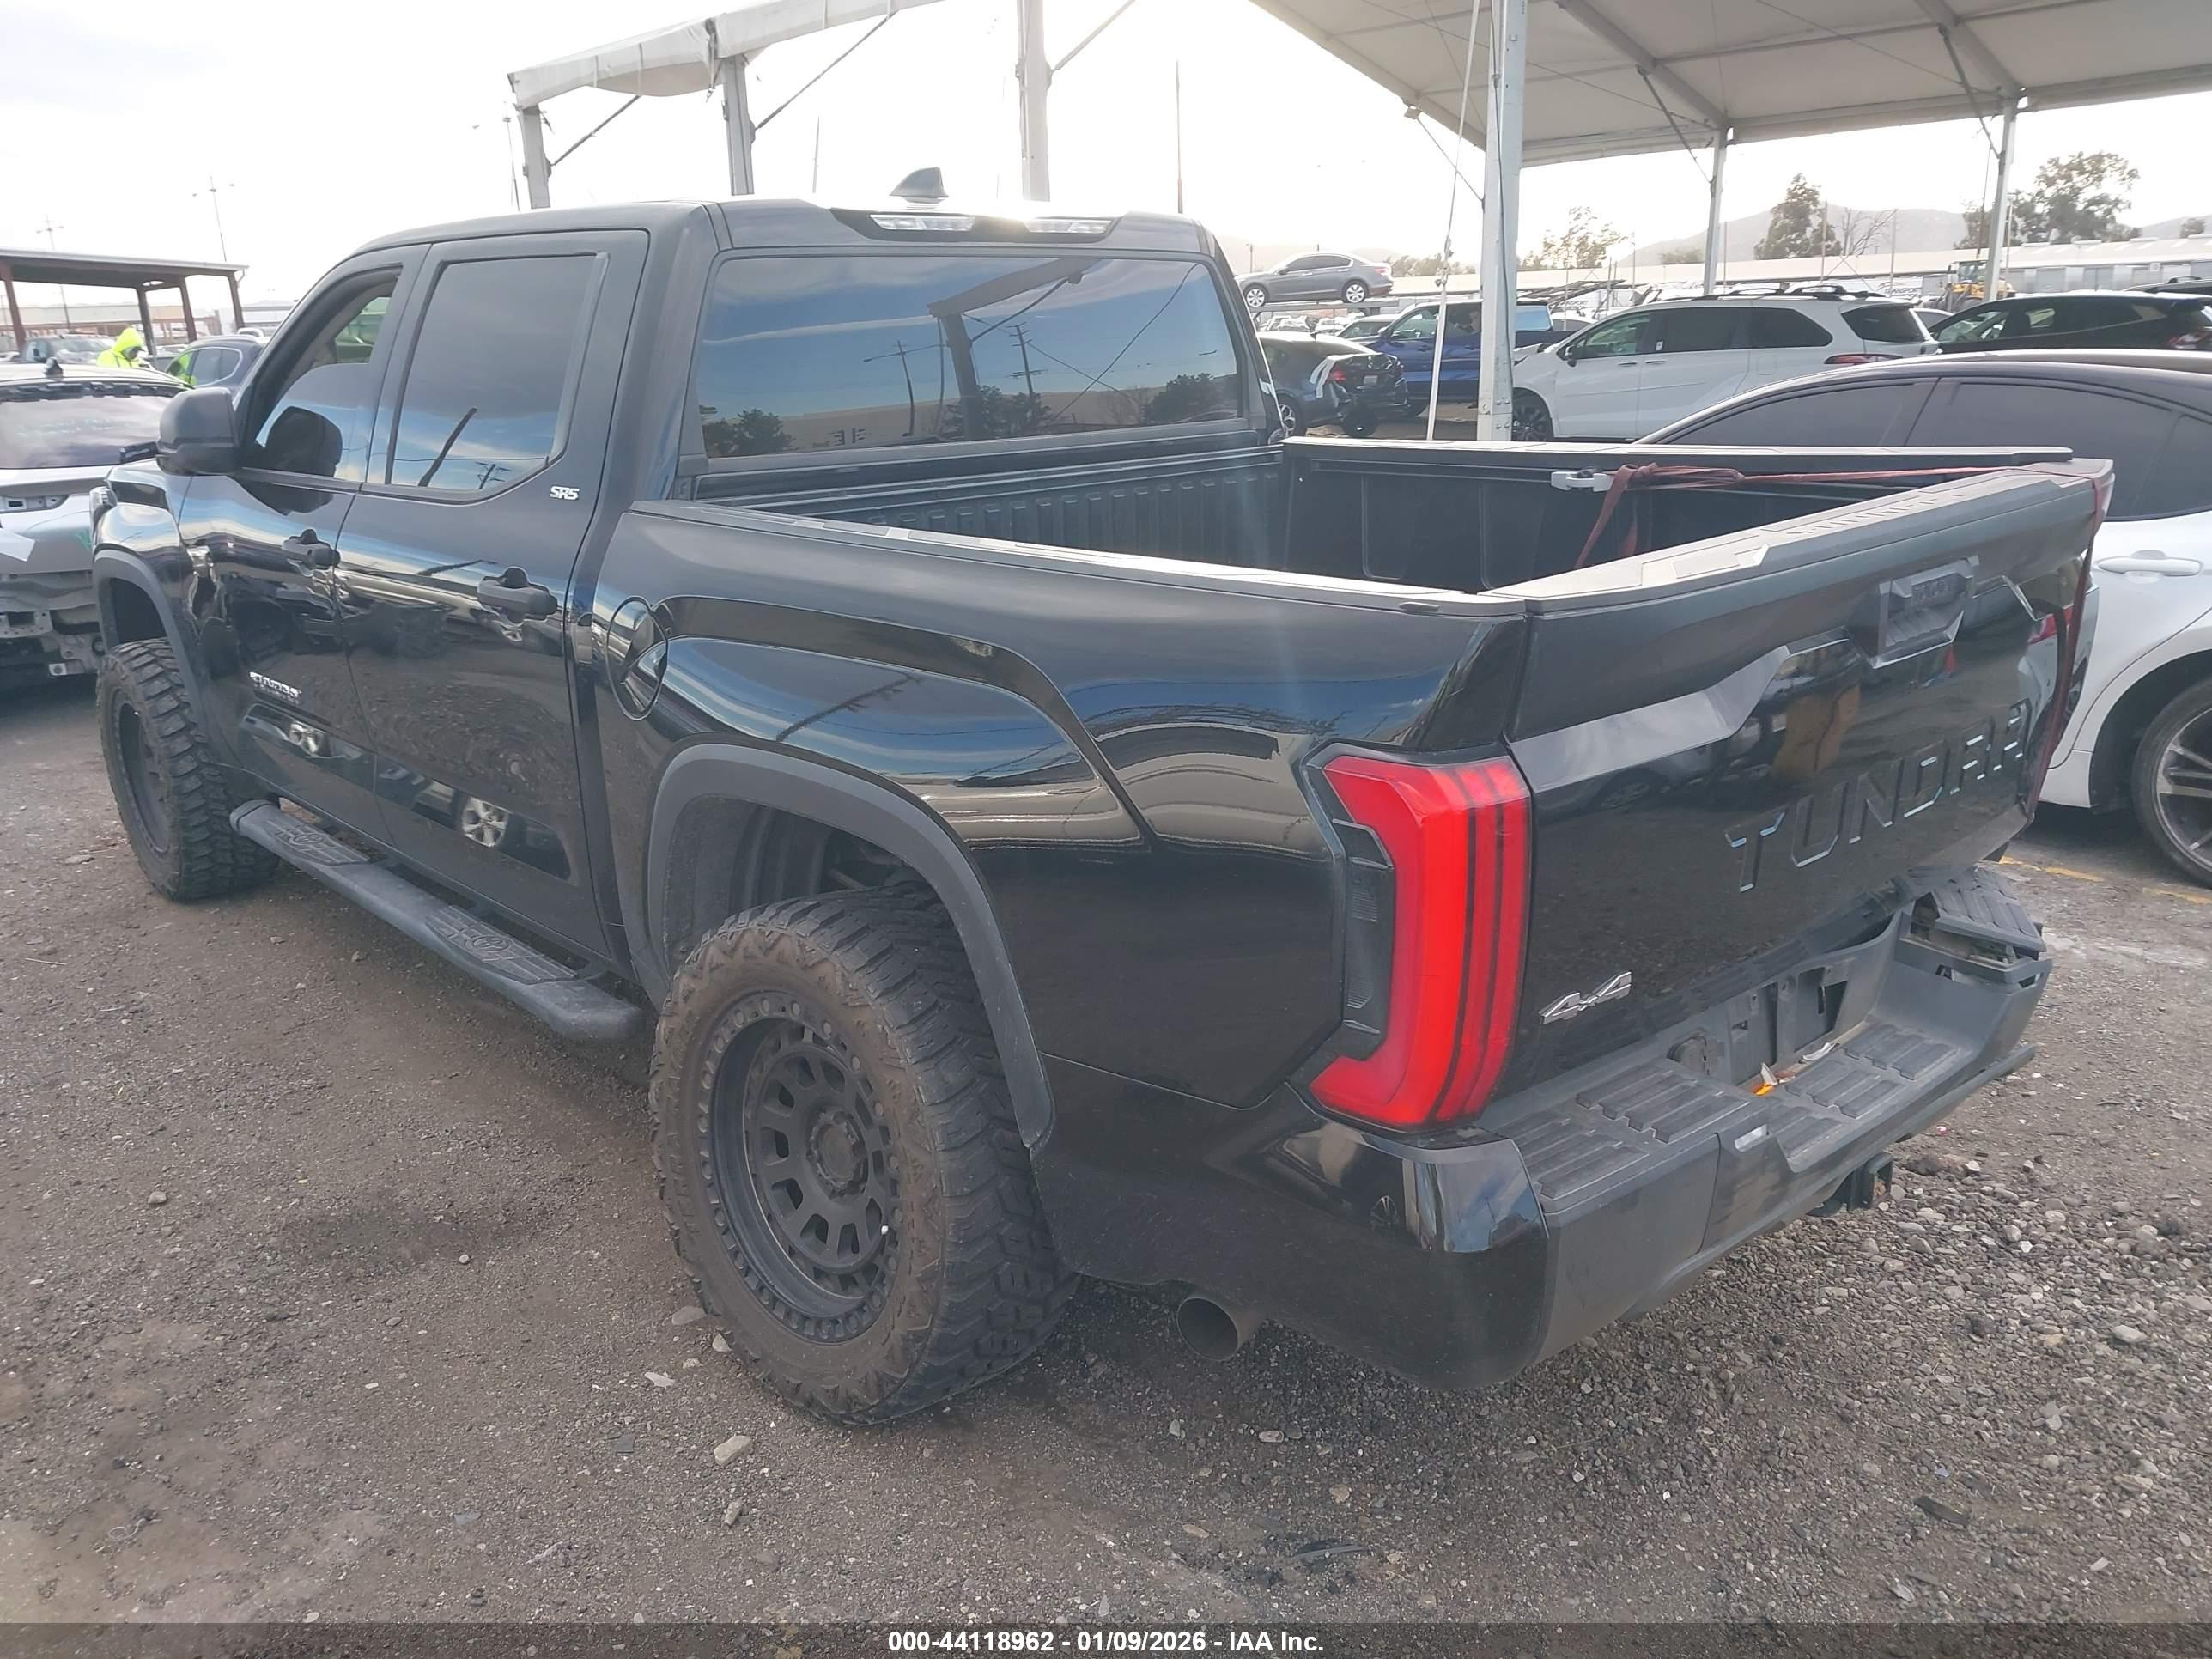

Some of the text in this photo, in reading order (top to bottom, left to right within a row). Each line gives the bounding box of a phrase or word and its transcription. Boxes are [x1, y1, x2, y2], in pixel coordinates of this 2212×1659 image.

[550, 485, 580, 500] SR5
[1725, 697, 2030, 893] TUNDRA
[1539, 970, 1632, 1024] 4x4
